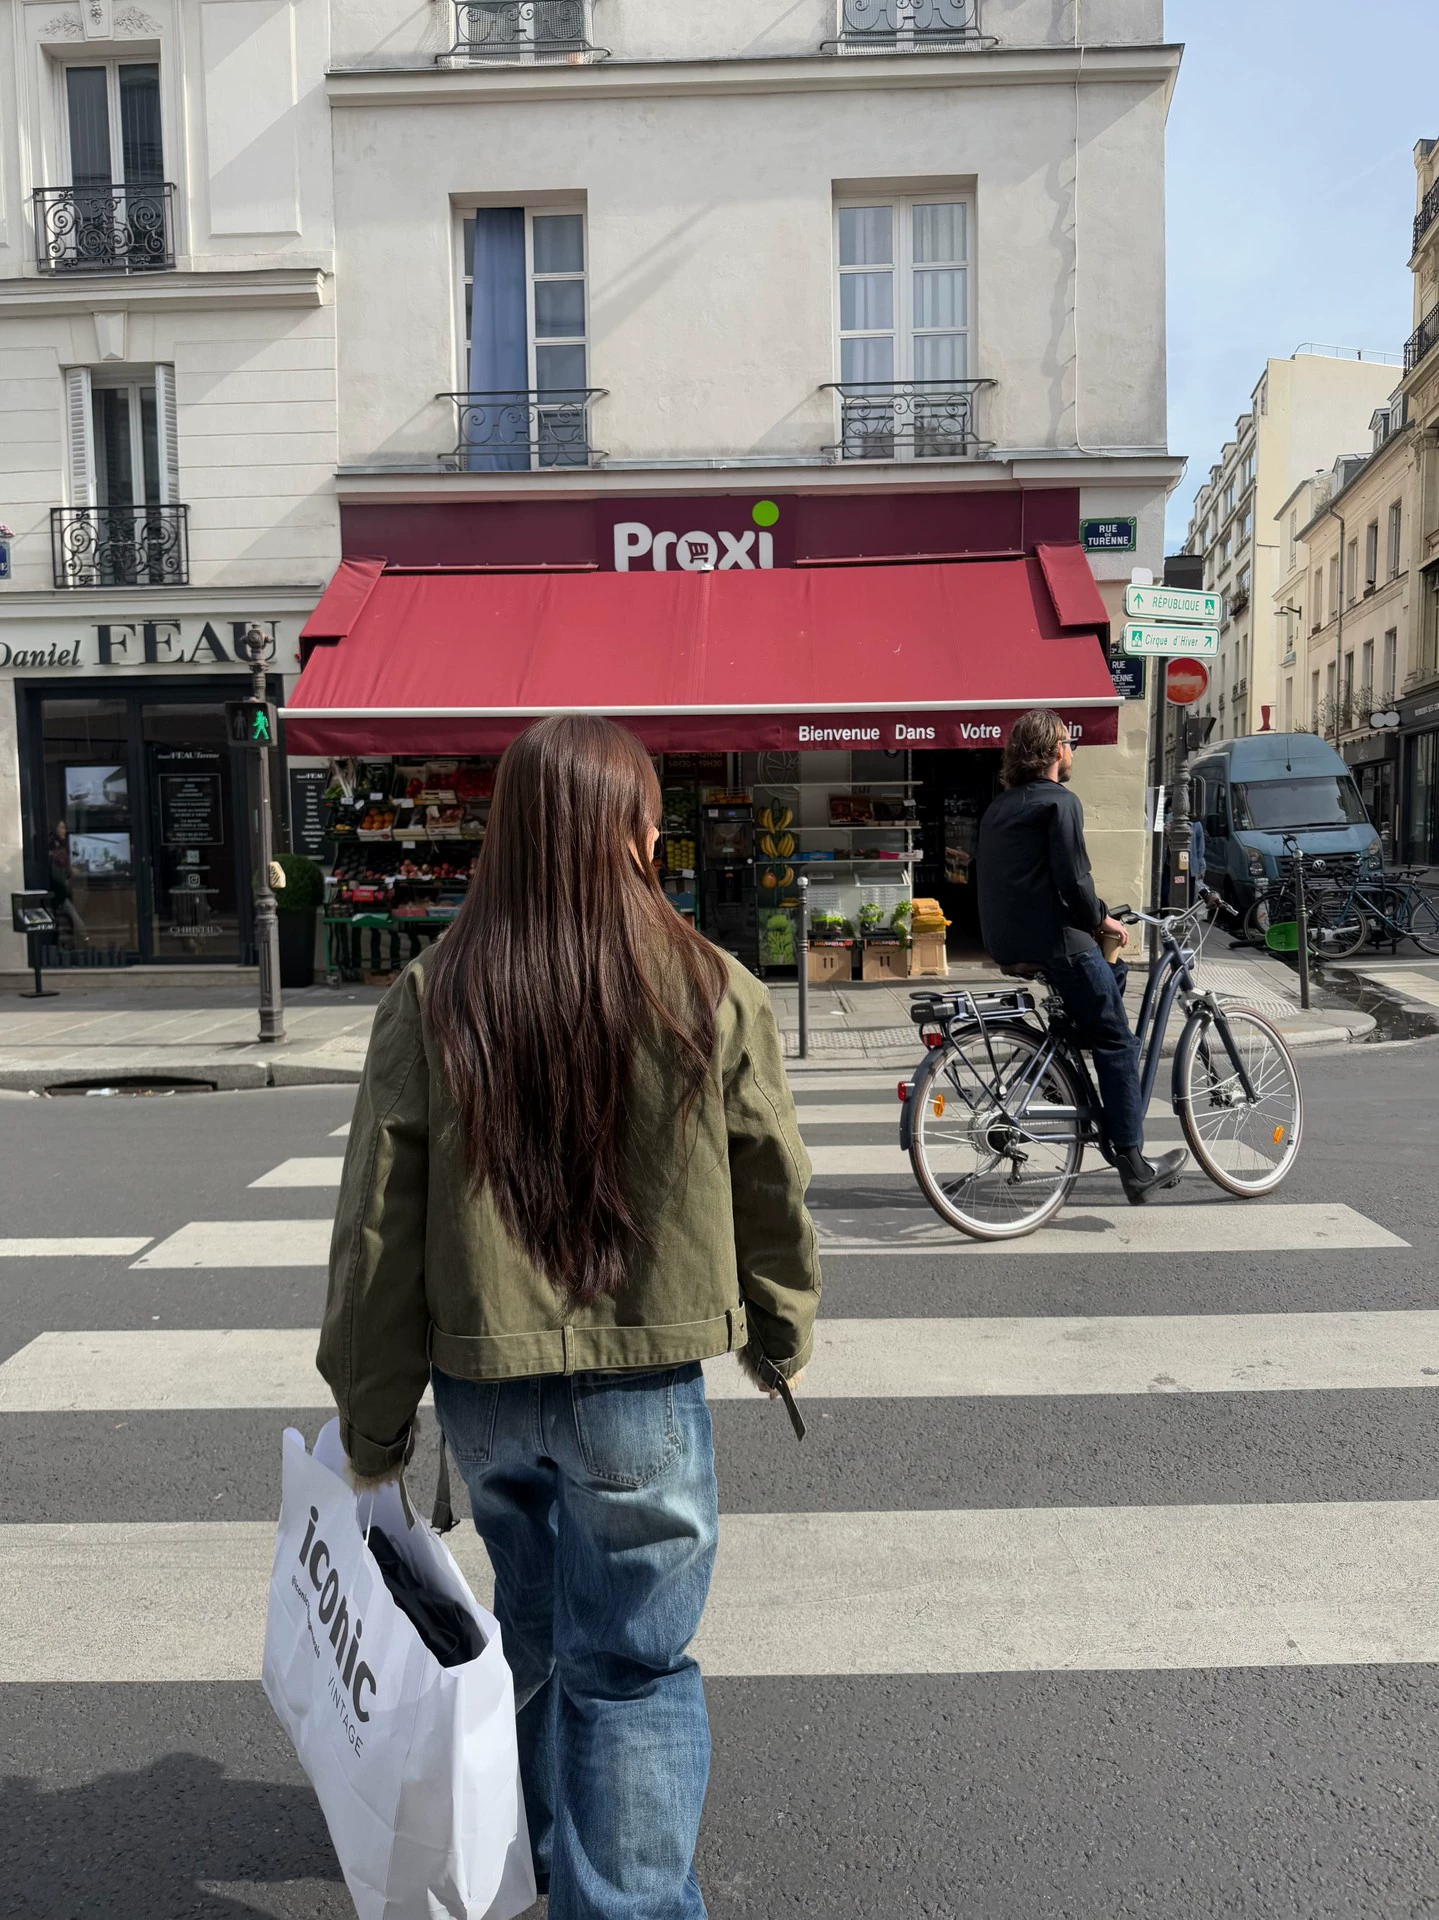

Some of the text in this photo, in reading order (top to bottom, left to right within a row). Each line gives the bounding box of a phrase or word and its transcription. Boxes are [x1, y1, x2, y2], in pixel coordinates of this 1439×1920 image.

[613, 500, 780, 572] Proxi
[1099, 524, 1118, 533] RUE
[1087, 536, 1129, 546] TURENNE
[1152, 595, 1200, 612] RÉPUBLIQUE
[1145, 633, 1199, 648] Cirque d'Hiver
[1112, 660, 1126, 669] RUE
[1111, 673, 1134, 682] RENNE
[798, 722, 1001, 742] Bienvenue Dans Votre
[298, 1505, 377, 1722] iconic
[328, 1668, 364, 1759] VINTAGE
